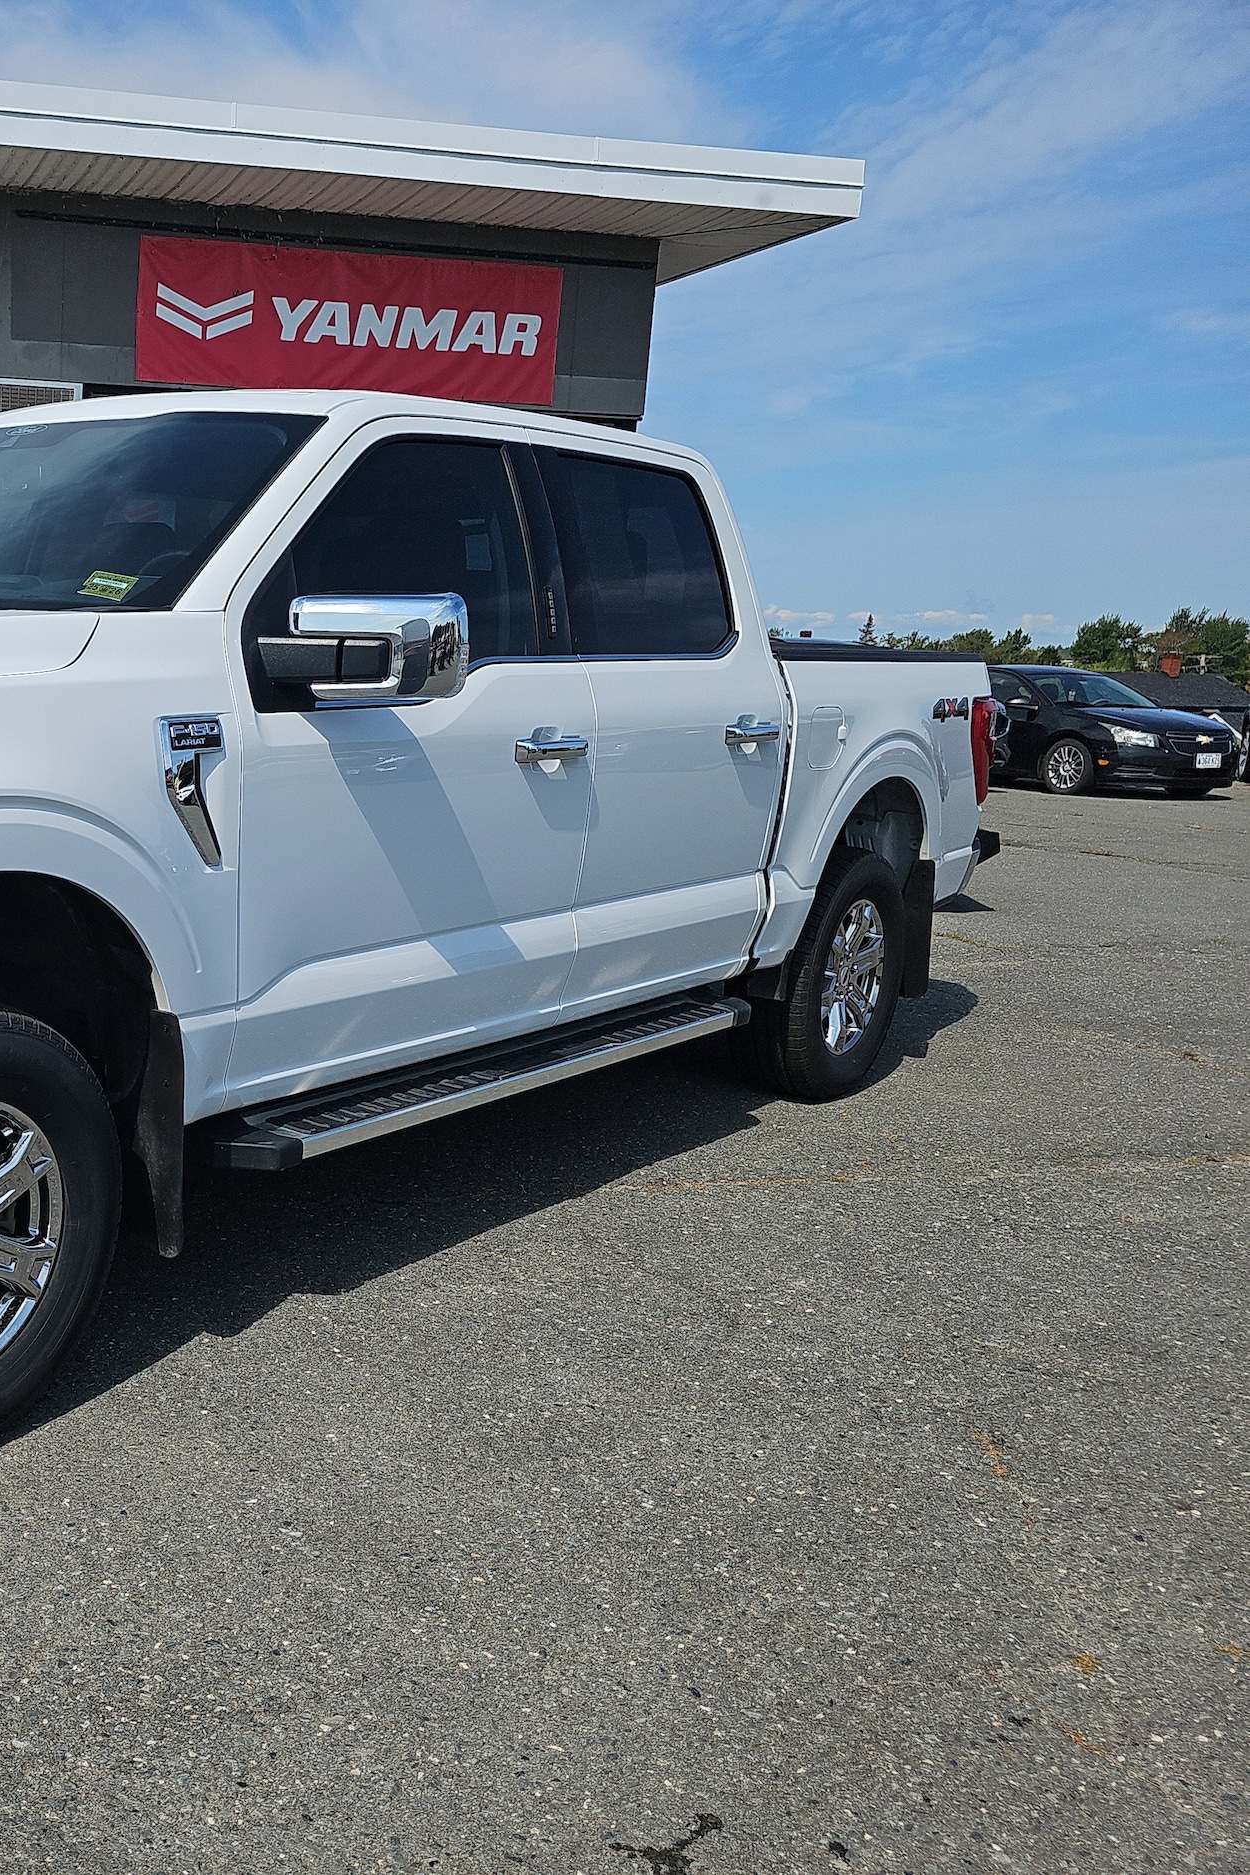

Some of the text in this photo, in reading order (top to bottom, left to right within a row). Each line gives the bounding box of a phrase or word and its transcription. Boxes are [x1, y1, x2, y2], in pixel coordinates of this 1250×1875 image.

[272, 297, 542, 356] YANMAR
[170, 723, 219, 737] F-150
[175, 738, 206, 747] LARIAT
